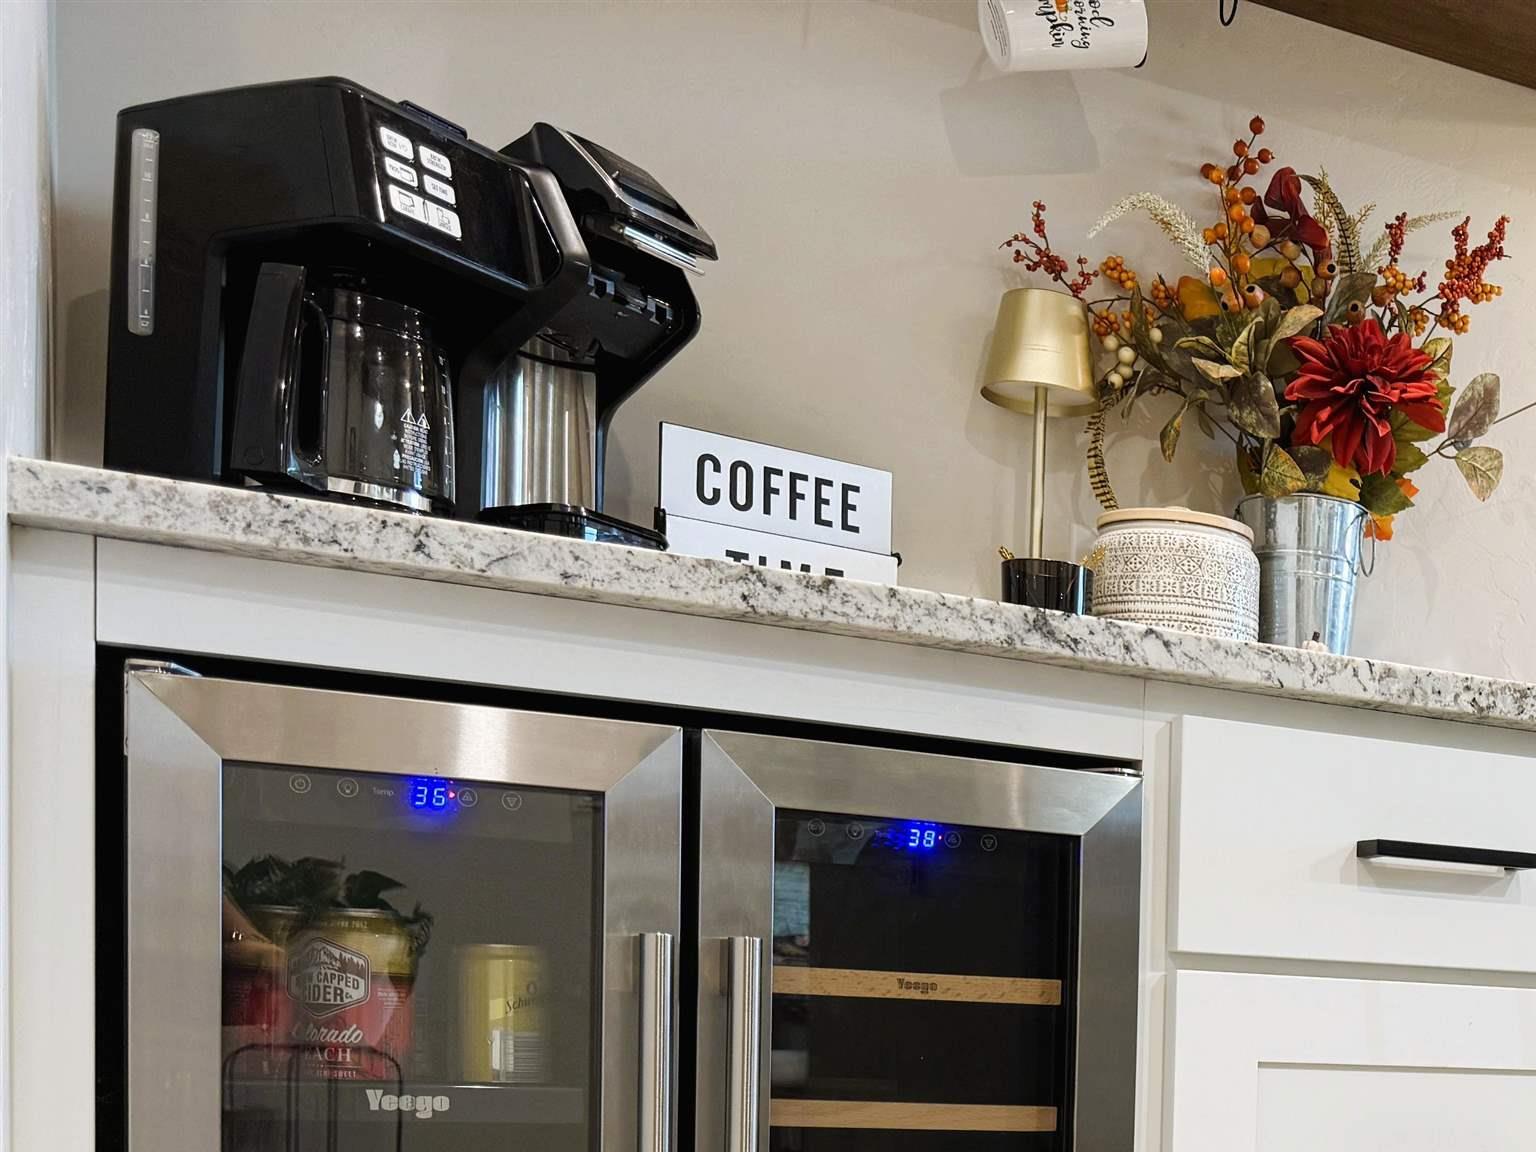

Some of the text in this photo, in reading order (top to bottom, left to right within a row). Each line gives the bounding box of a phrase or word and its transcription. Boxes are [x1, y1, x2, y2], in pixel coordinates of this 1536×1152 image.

[1035, 0, 1074, 48] mpkin
[1071, 0, 1090, 49] orning
[696, 453, 861, 534] COFFEE
[908, 828, 936, 848] 38
[316, 970, 360, 991] CAPPED
[365, 1089, 450, 1119] Yeego
